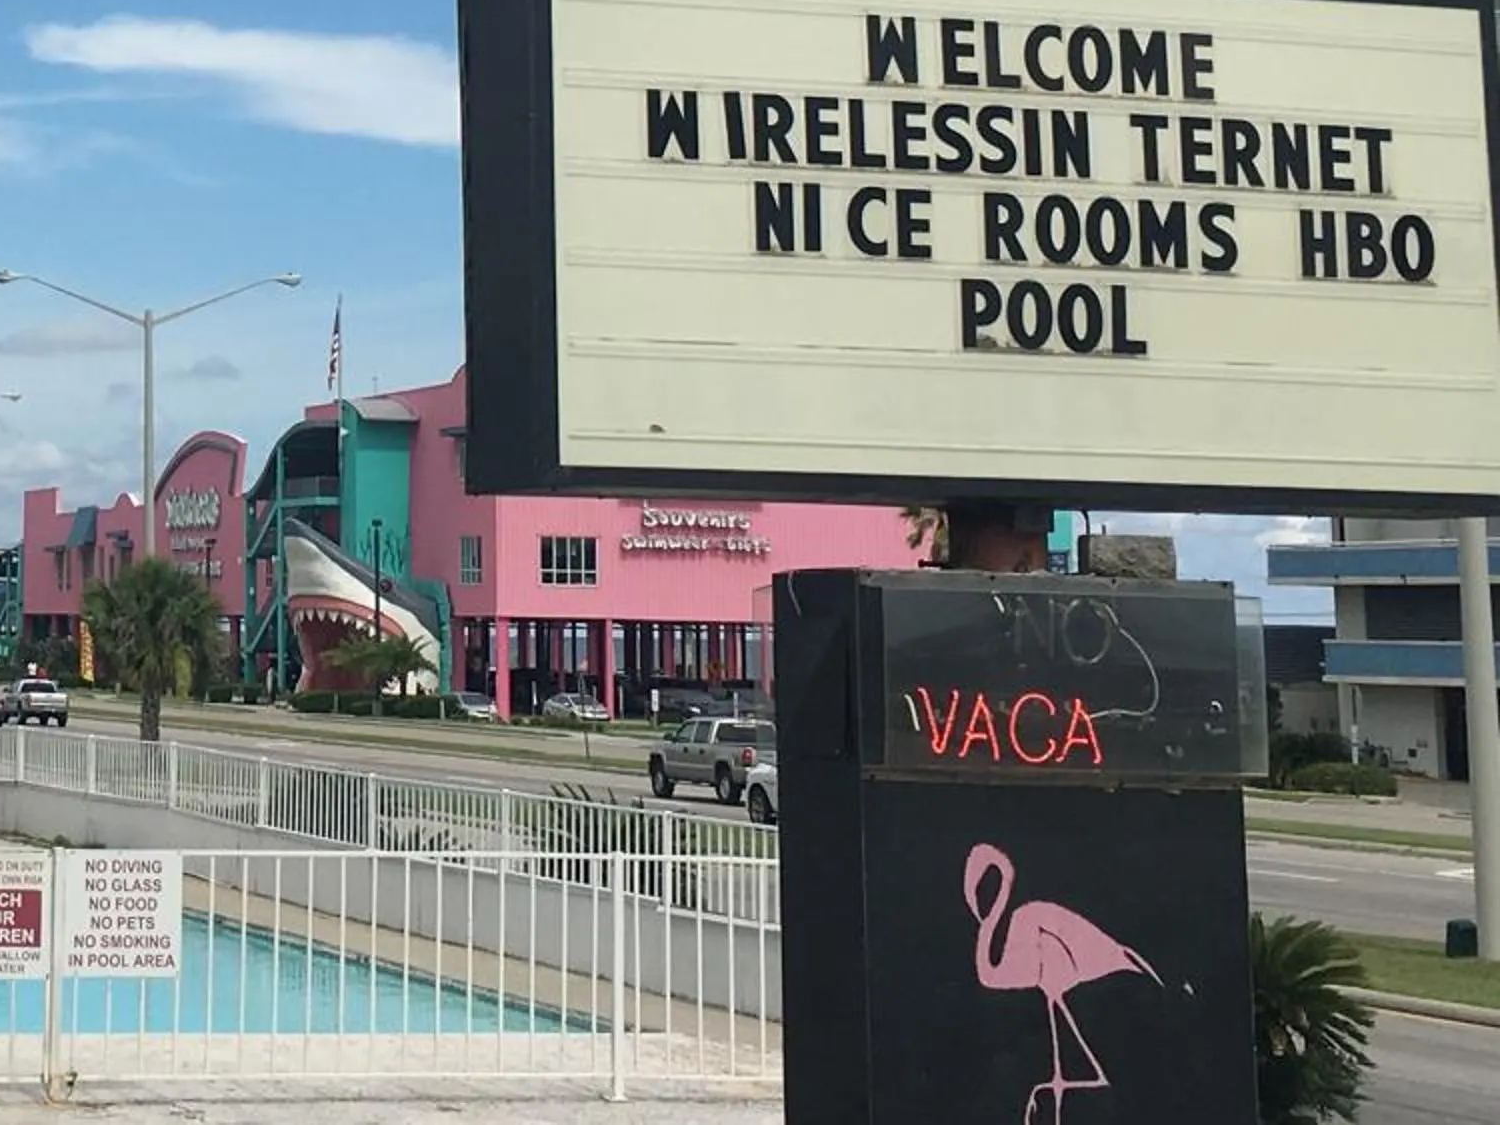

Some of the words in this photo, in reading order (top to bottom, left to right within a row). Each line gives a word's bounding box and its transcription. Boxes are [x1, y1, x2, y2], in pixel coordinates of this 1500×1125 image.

[865, 14, 1215, 101] WELCOME
[754, 181, 933, 259] NICE
[983, 191, 1238, 273] ROOMS
[1300, 209, 1435, 282] HBO
[961, 278, 1148, 355] POOL
[1014, 595, 1112, 665] NO
[915, 686, 1104, 765] VACA
[85, 859, 108, 873] NO
[111, 859, 163, 874] DIVING
[85, 878, 107, 892] NO
[111, 878, 162, 892] GLASS
[88, 897, 111, 911] NO
[115, 897, 158, 911] FOOD
[90, 916, 113, 930] NO
[116, 916, 155, 930] PETS
[73, 934, 96, 948] NO
[99, 934, 171, 949] SMOKING
[67, 954, 83, 968] IN
[87, 954, 129, 968] POOL
[133, 954, 176, 968] AREA
